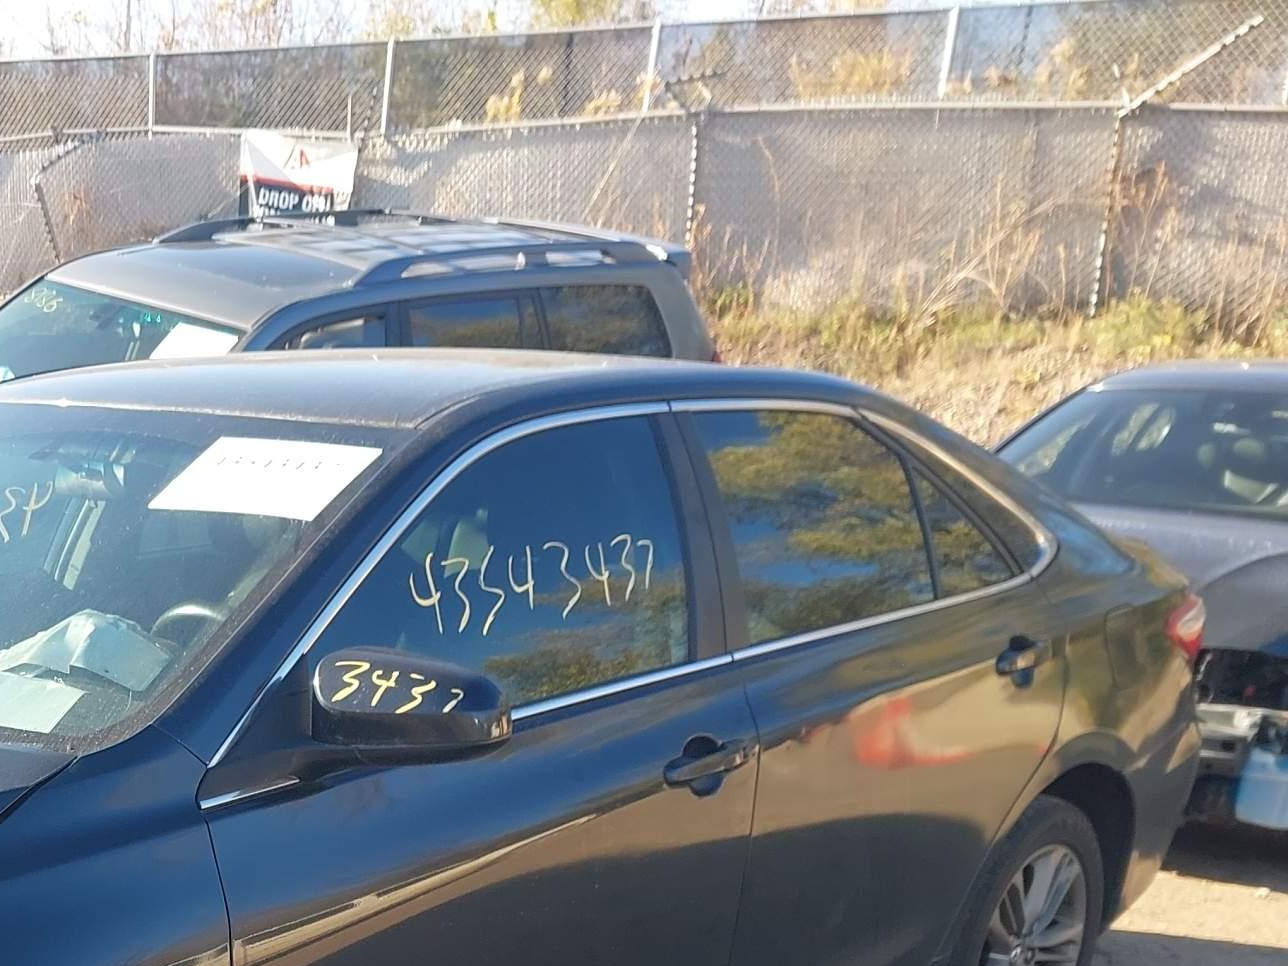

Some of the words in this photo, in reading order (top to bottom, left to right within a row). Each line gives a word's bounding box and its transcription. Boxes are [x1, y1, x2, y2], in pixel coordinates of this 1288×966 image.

[257, 186, 299, 211] DROP
[409, 534, 654, 636] 43543437
[331, 661, 464, 714] 3437
